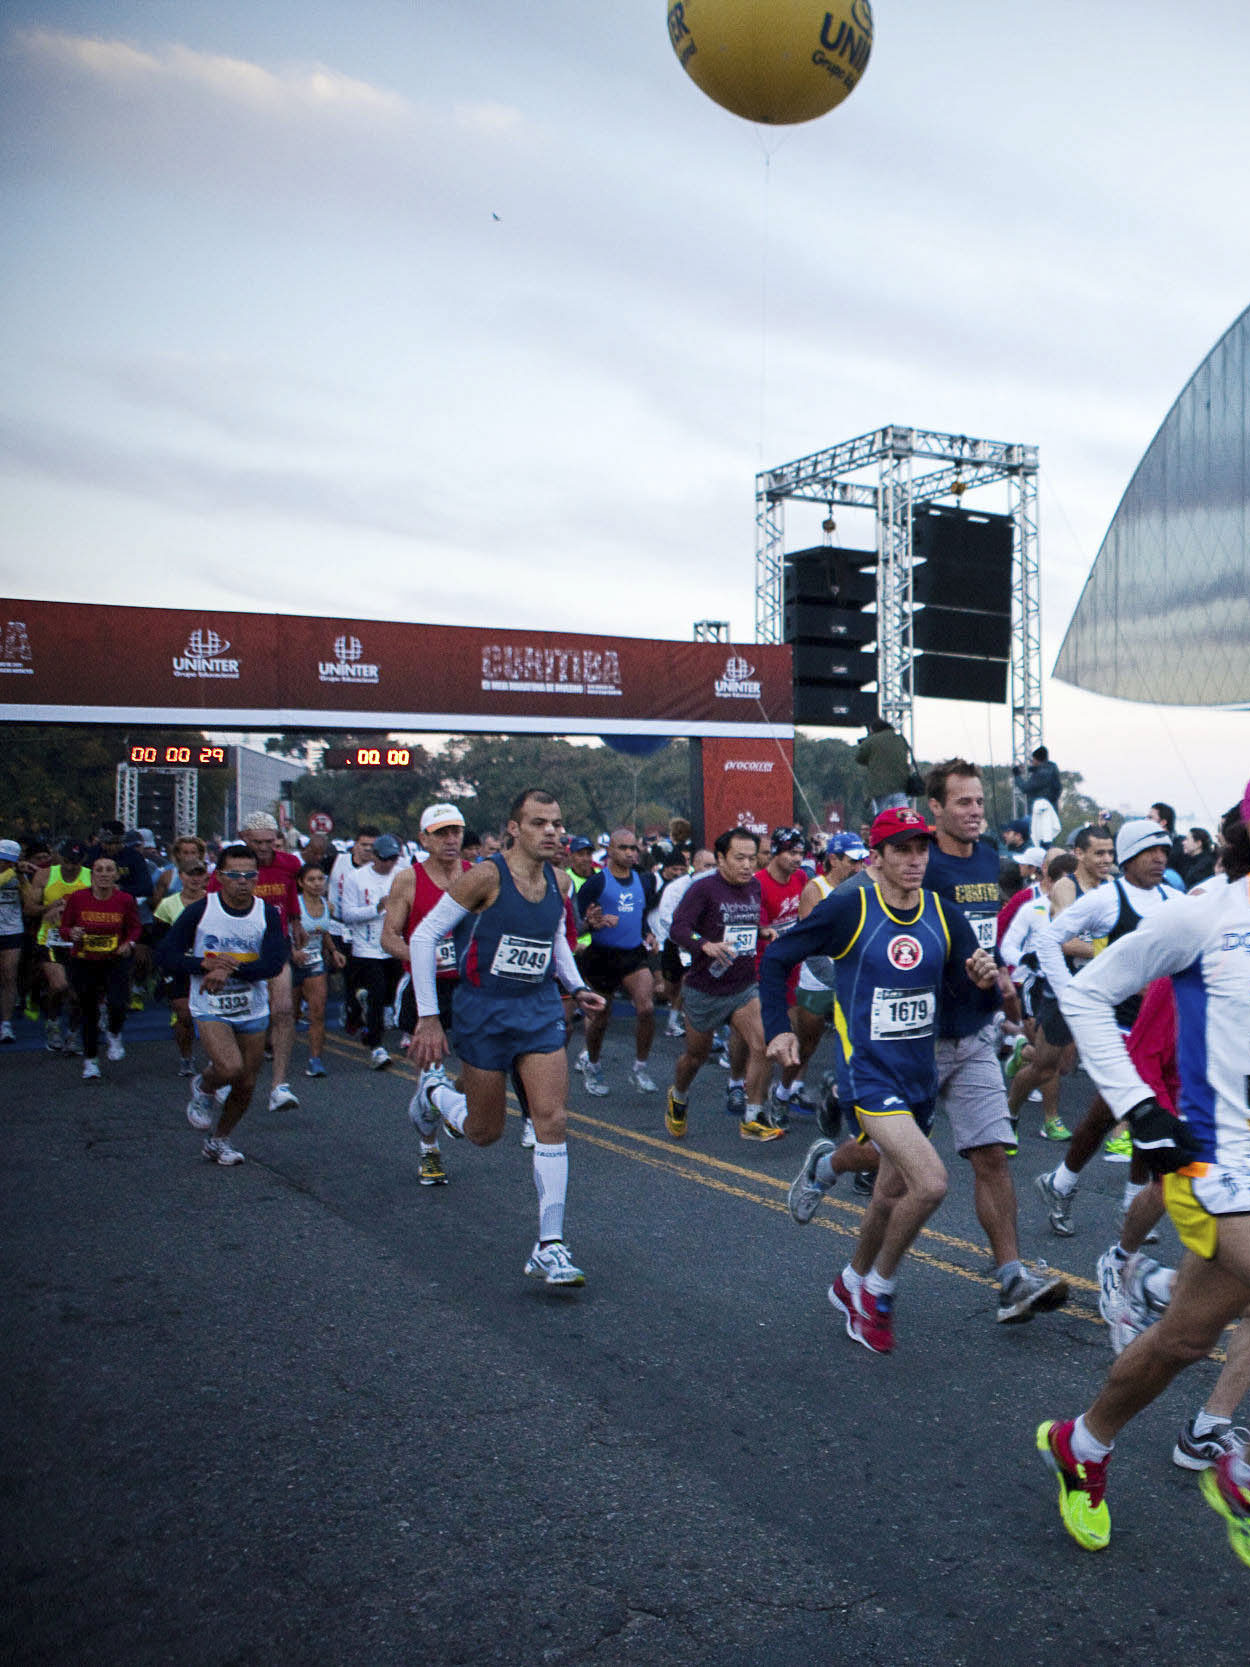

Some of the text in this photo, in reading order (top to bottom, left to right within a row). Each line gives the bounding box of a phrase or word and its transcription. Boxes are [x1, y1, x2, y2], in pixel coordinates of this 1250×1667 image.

[173, 657, 240, 672] UNINTER
[318, 661, 380, 678] UNINTER
[715, 680, 761, 693] UNINTER
[131, 747, 224, 763] 00 00 29
[387, 749, 410, 766] 00
[506, 948, 546, 970] 2049
[889, 1000, 928, 1022] 1679
